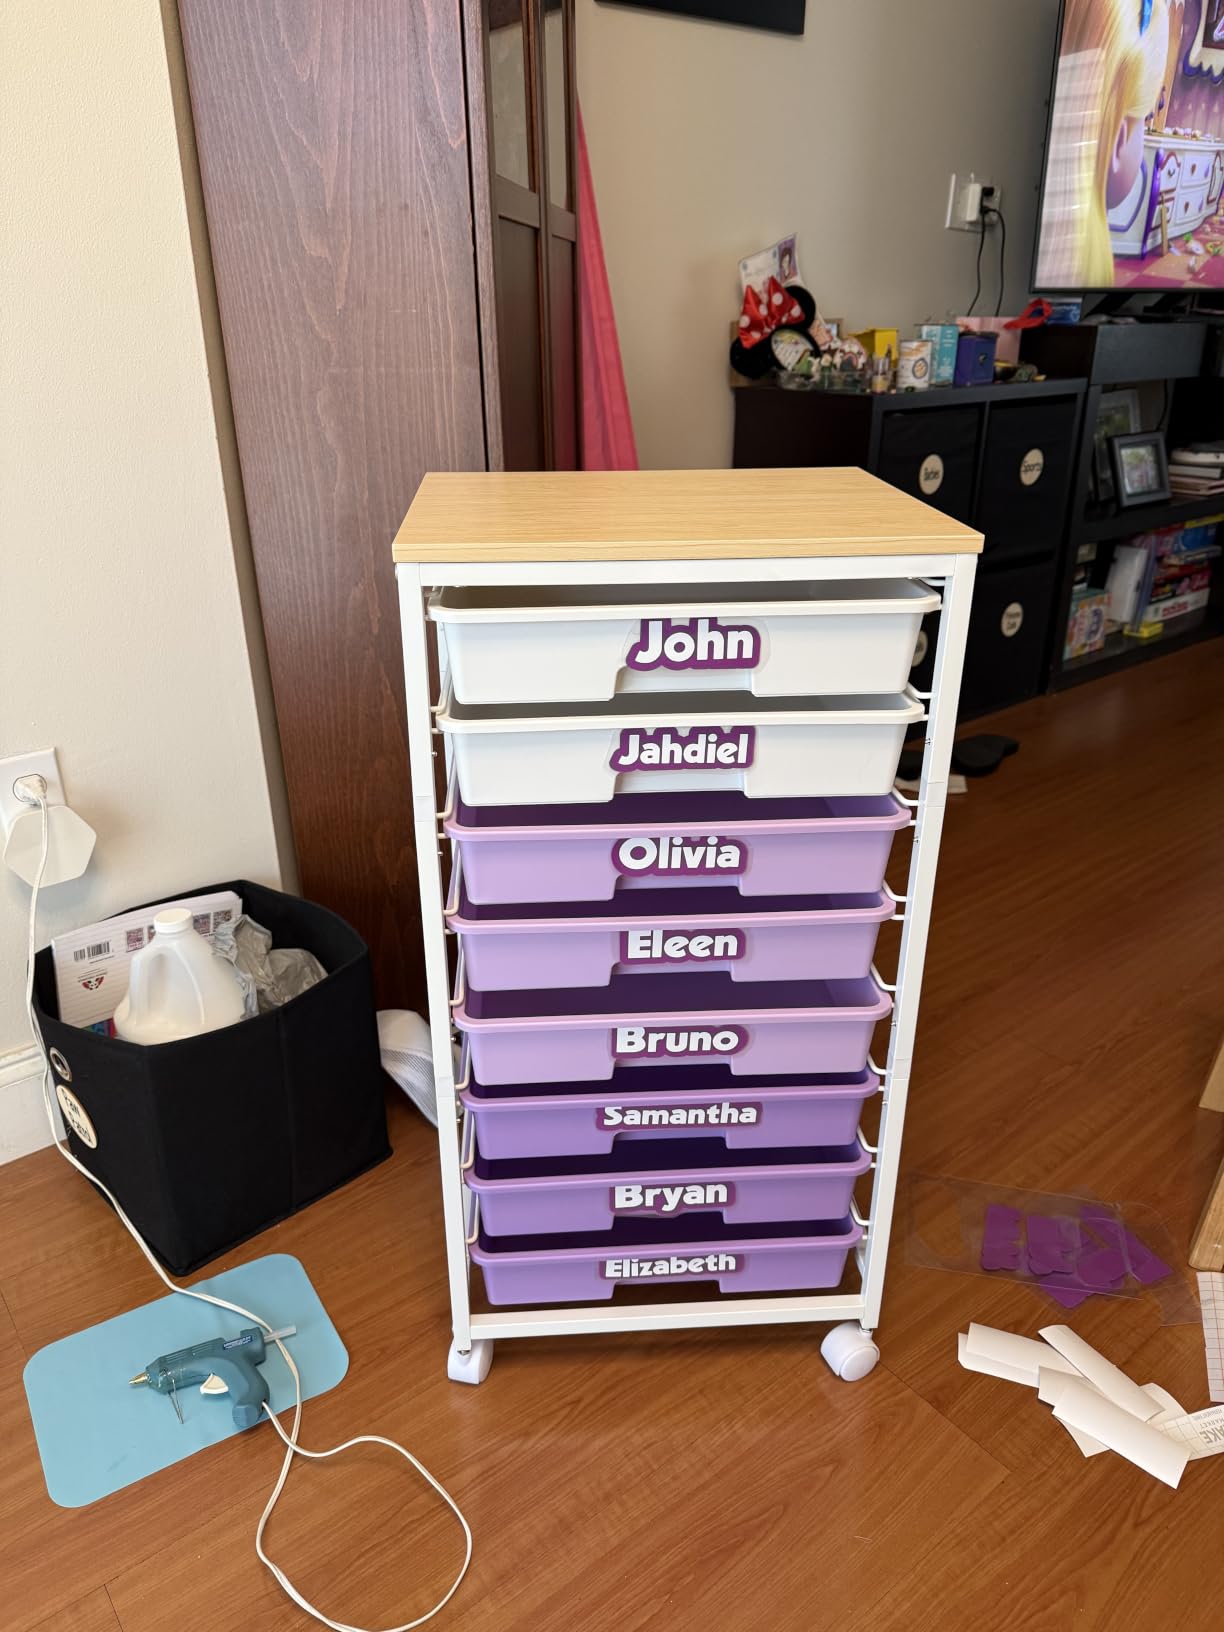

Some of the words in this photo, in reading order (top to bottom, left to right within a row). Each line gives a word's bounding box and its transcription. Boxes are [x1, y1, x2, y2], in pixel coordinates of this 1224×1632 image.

[634, 619, 754, 664] John
[618, 733, 749, 764] Jahdiel
[618, 837, 741, 870] Olivia
[627, 929, 738, 959] Eleen
[616, 1026, 739, 1053] Bruno
[604, 1102, 757, 1126] Samantha
[614, 1183, 728, 1212] Bryan
[605, 1254, 736, 1278] Elizabeth
[1199, 1424, 1224, 1444] AKE
